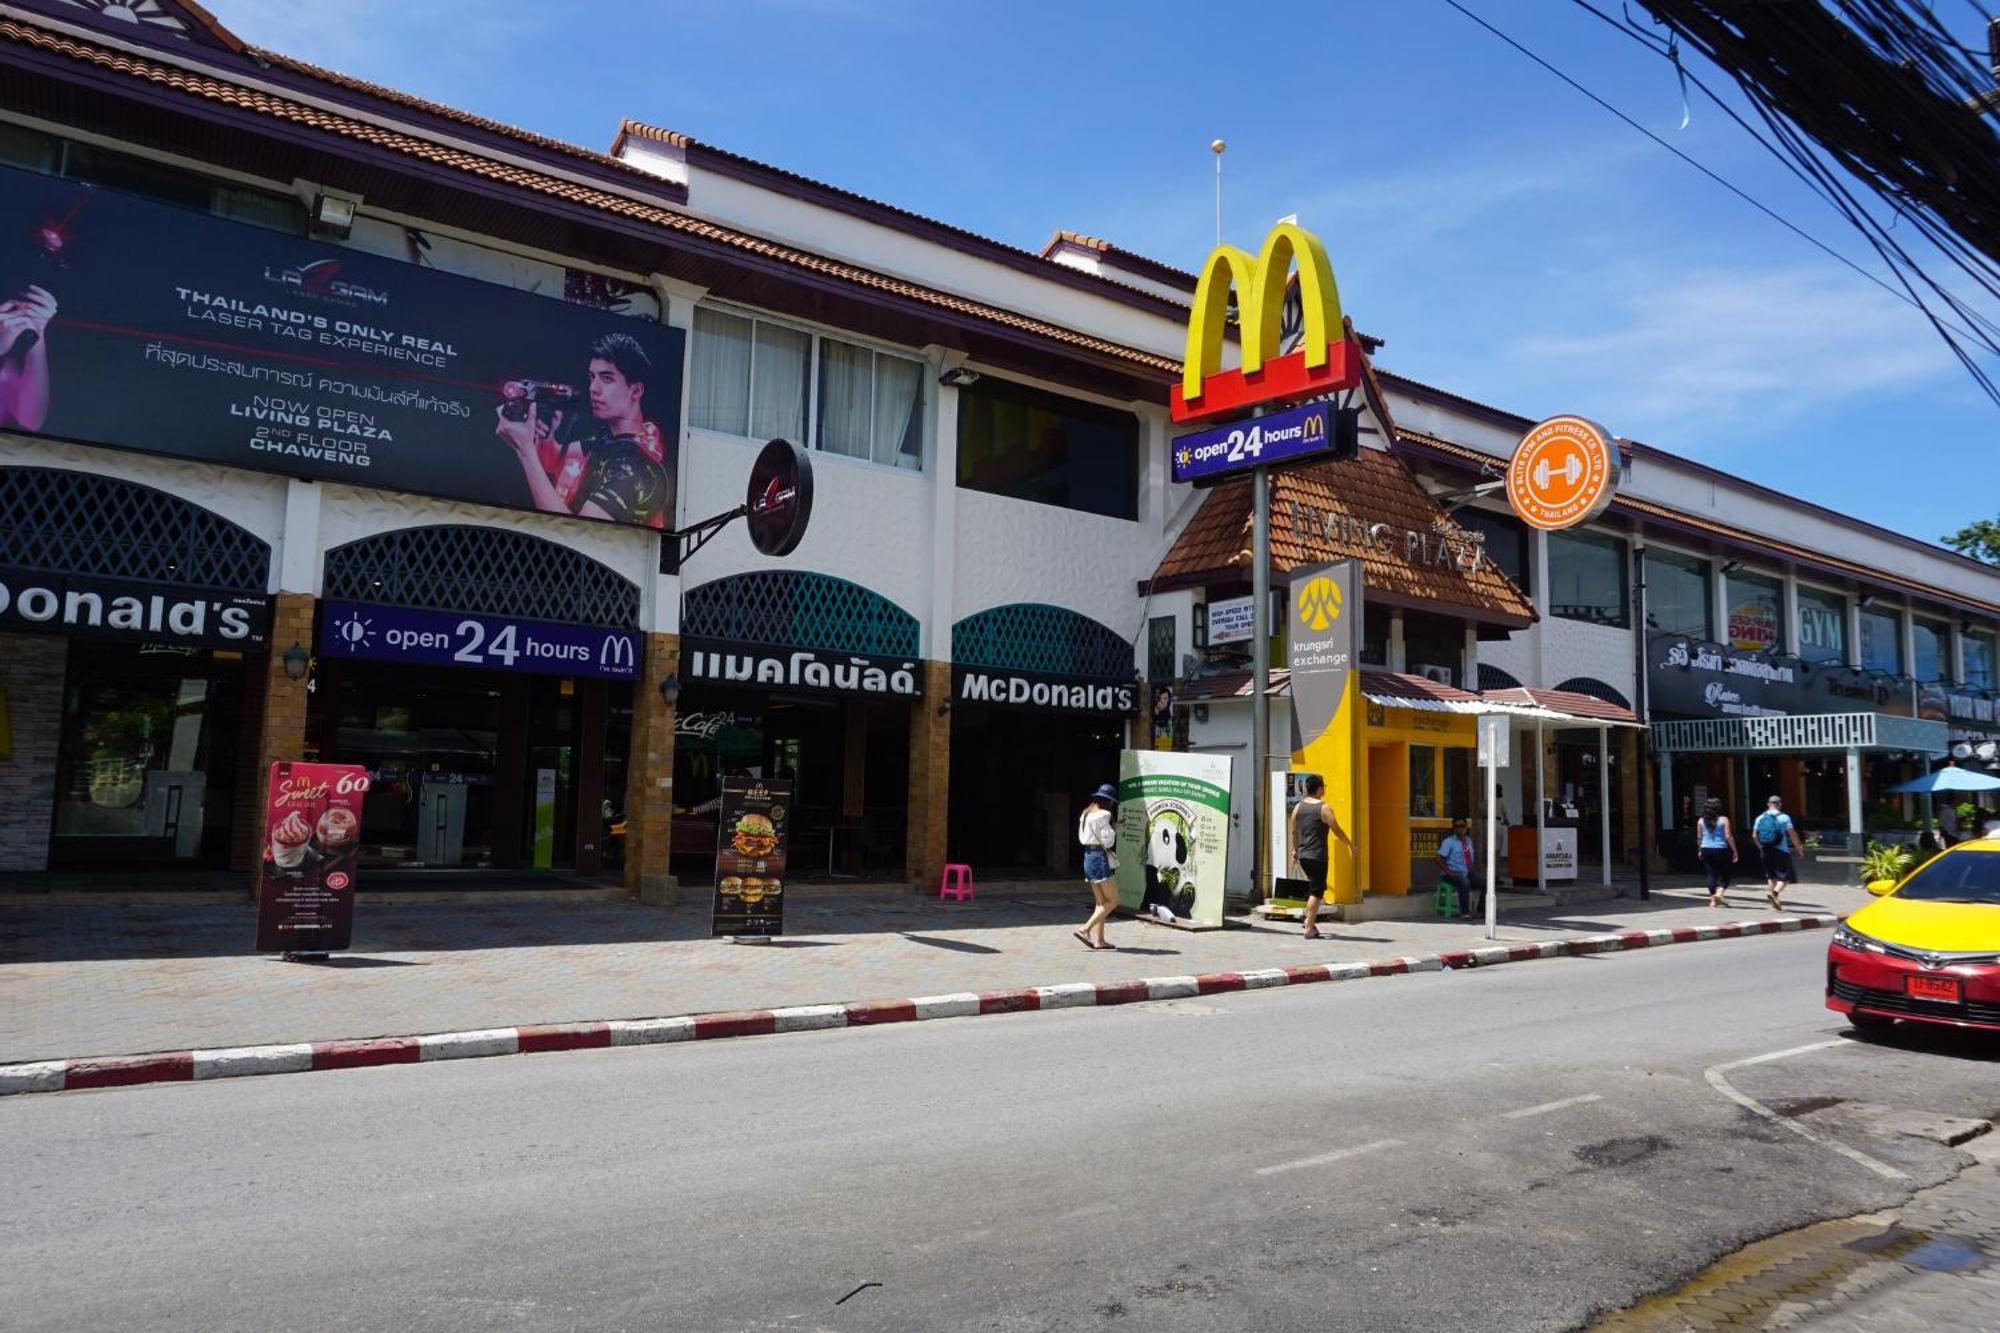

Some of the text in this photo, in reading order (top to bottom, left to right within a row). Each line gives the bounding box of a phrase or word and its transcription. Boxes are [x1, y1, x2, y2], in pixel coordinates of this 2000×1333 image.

[176, 287, 459, 356] THAILAND'S ONLY REAL
[187, 305, 447, 368] LASER TAG EXPERIENCE
[230, 403, 393, 441] LIVING PLAZA
[253, 395, 375, 426] NOW OPEN
[250, 438, 371, 467] CHAWENG
[256, 426, 368, 454] 2ND FLOOR
[1194, 425, 1302, 463] open 24 hours
[1521, 439, 1537, 459] GYM
[1536, 427, 1554, 441] AND
[1555, 424, 1590, 441] FITNESS
[1540, 504, 1579, 518] THAILAND
[1292, 501, 1492, 575] LIVING PLAZA
[0, 582, 250, 640] onald's
[1799, 607, 1842, 650] GYM
[386, 619, 590, 667] open 24 hours
[1294, 637, 1334, 652] krungsri
[1294, 652, 1348, 667] exchange
[692, 651, 915, 696] แมคโดนัลด์
[962, 673, 1133, 711] McDonald's
[275, 778, 330, 808] Sweet
